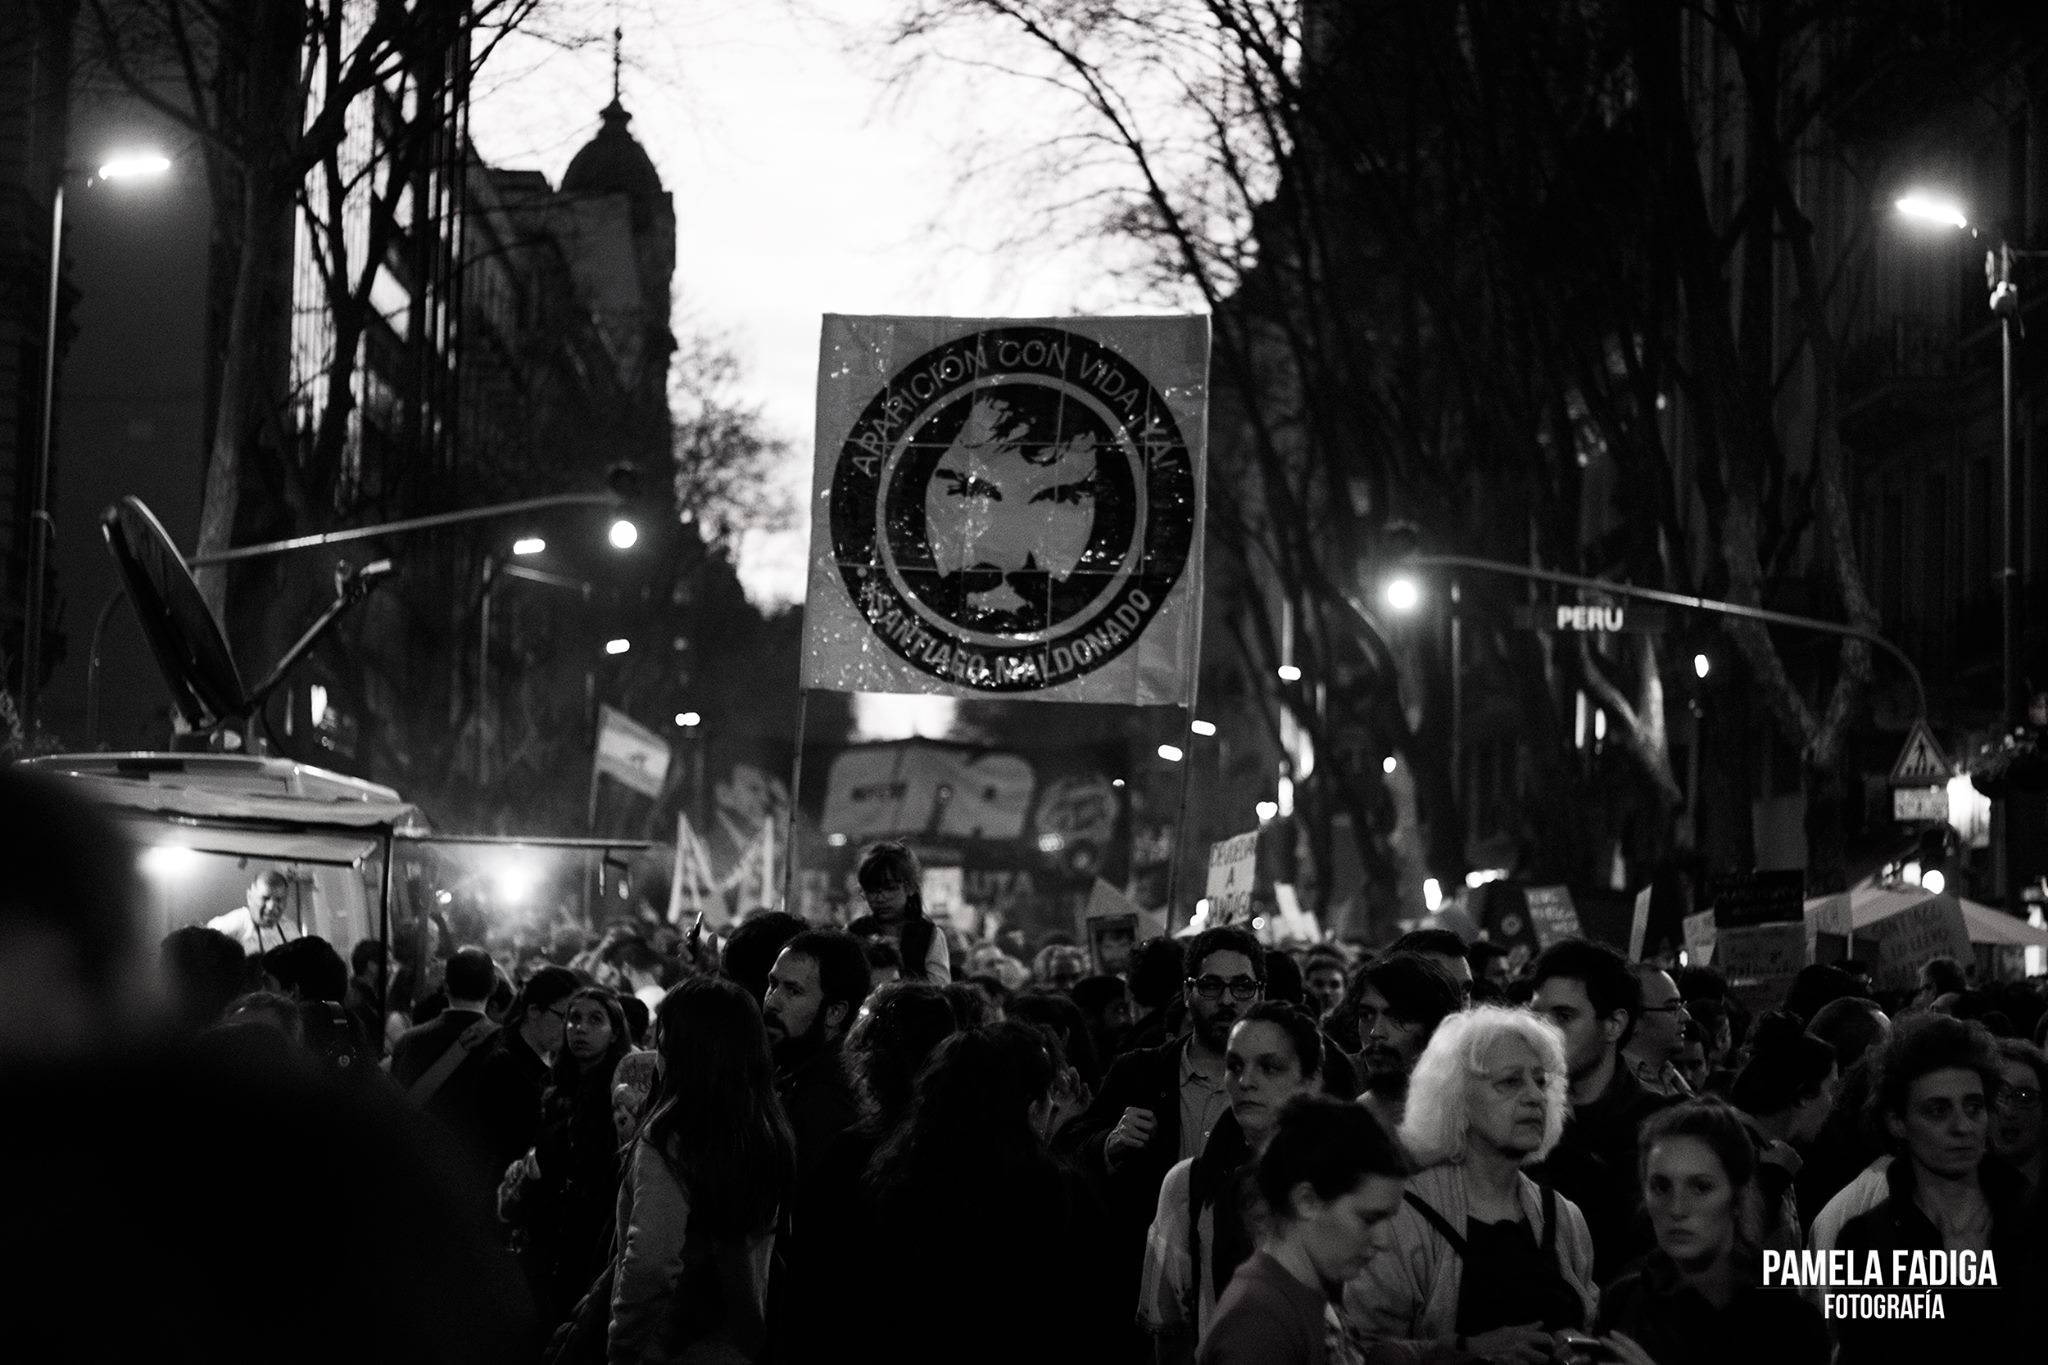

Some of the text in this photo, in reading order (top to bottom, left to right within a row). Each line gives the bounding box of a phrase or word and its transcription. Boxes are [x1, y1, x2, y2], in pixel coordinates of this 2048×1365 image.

[998, 340, 1071, 372] CON
[1079, 352, 1140, 413] VIDA
[868, 587, 1151, 684] SANTIAGO MALDONADO
